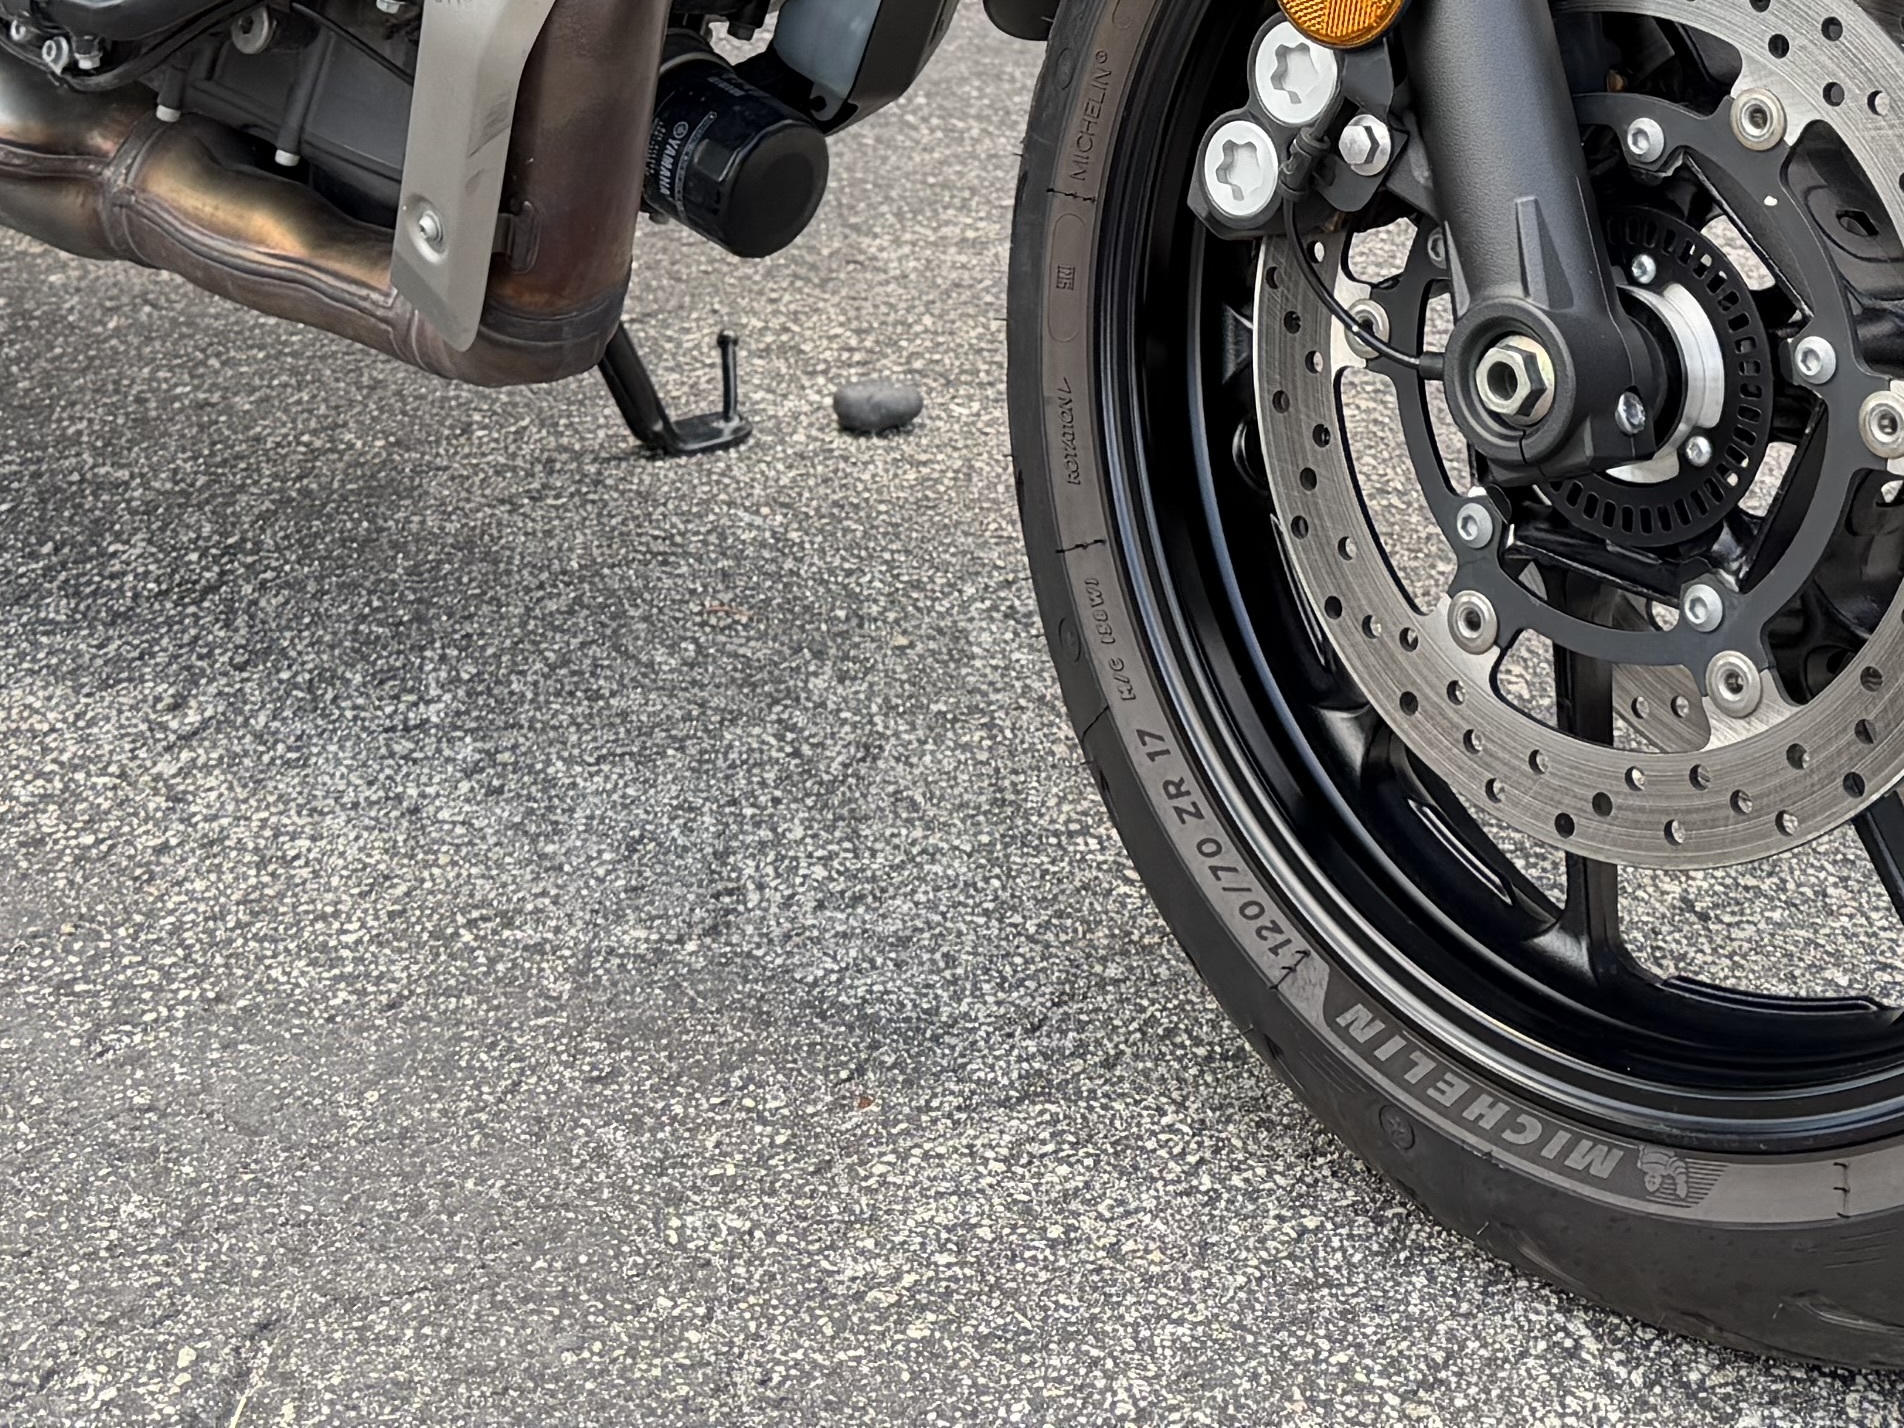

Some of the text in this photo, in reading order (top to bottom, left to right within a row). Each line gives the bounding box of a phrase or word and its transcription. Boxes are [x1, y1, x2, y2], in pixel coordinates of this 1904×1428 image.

[659, 137, 684, 196] YAMAHA
[1135, 728, 1172, 763] 17
[1162, 776, 1206, 826] ZR
[1195, 837, 1293, 957] 120/70
[1336, 1003, 1624, 1179] MICHELIN
